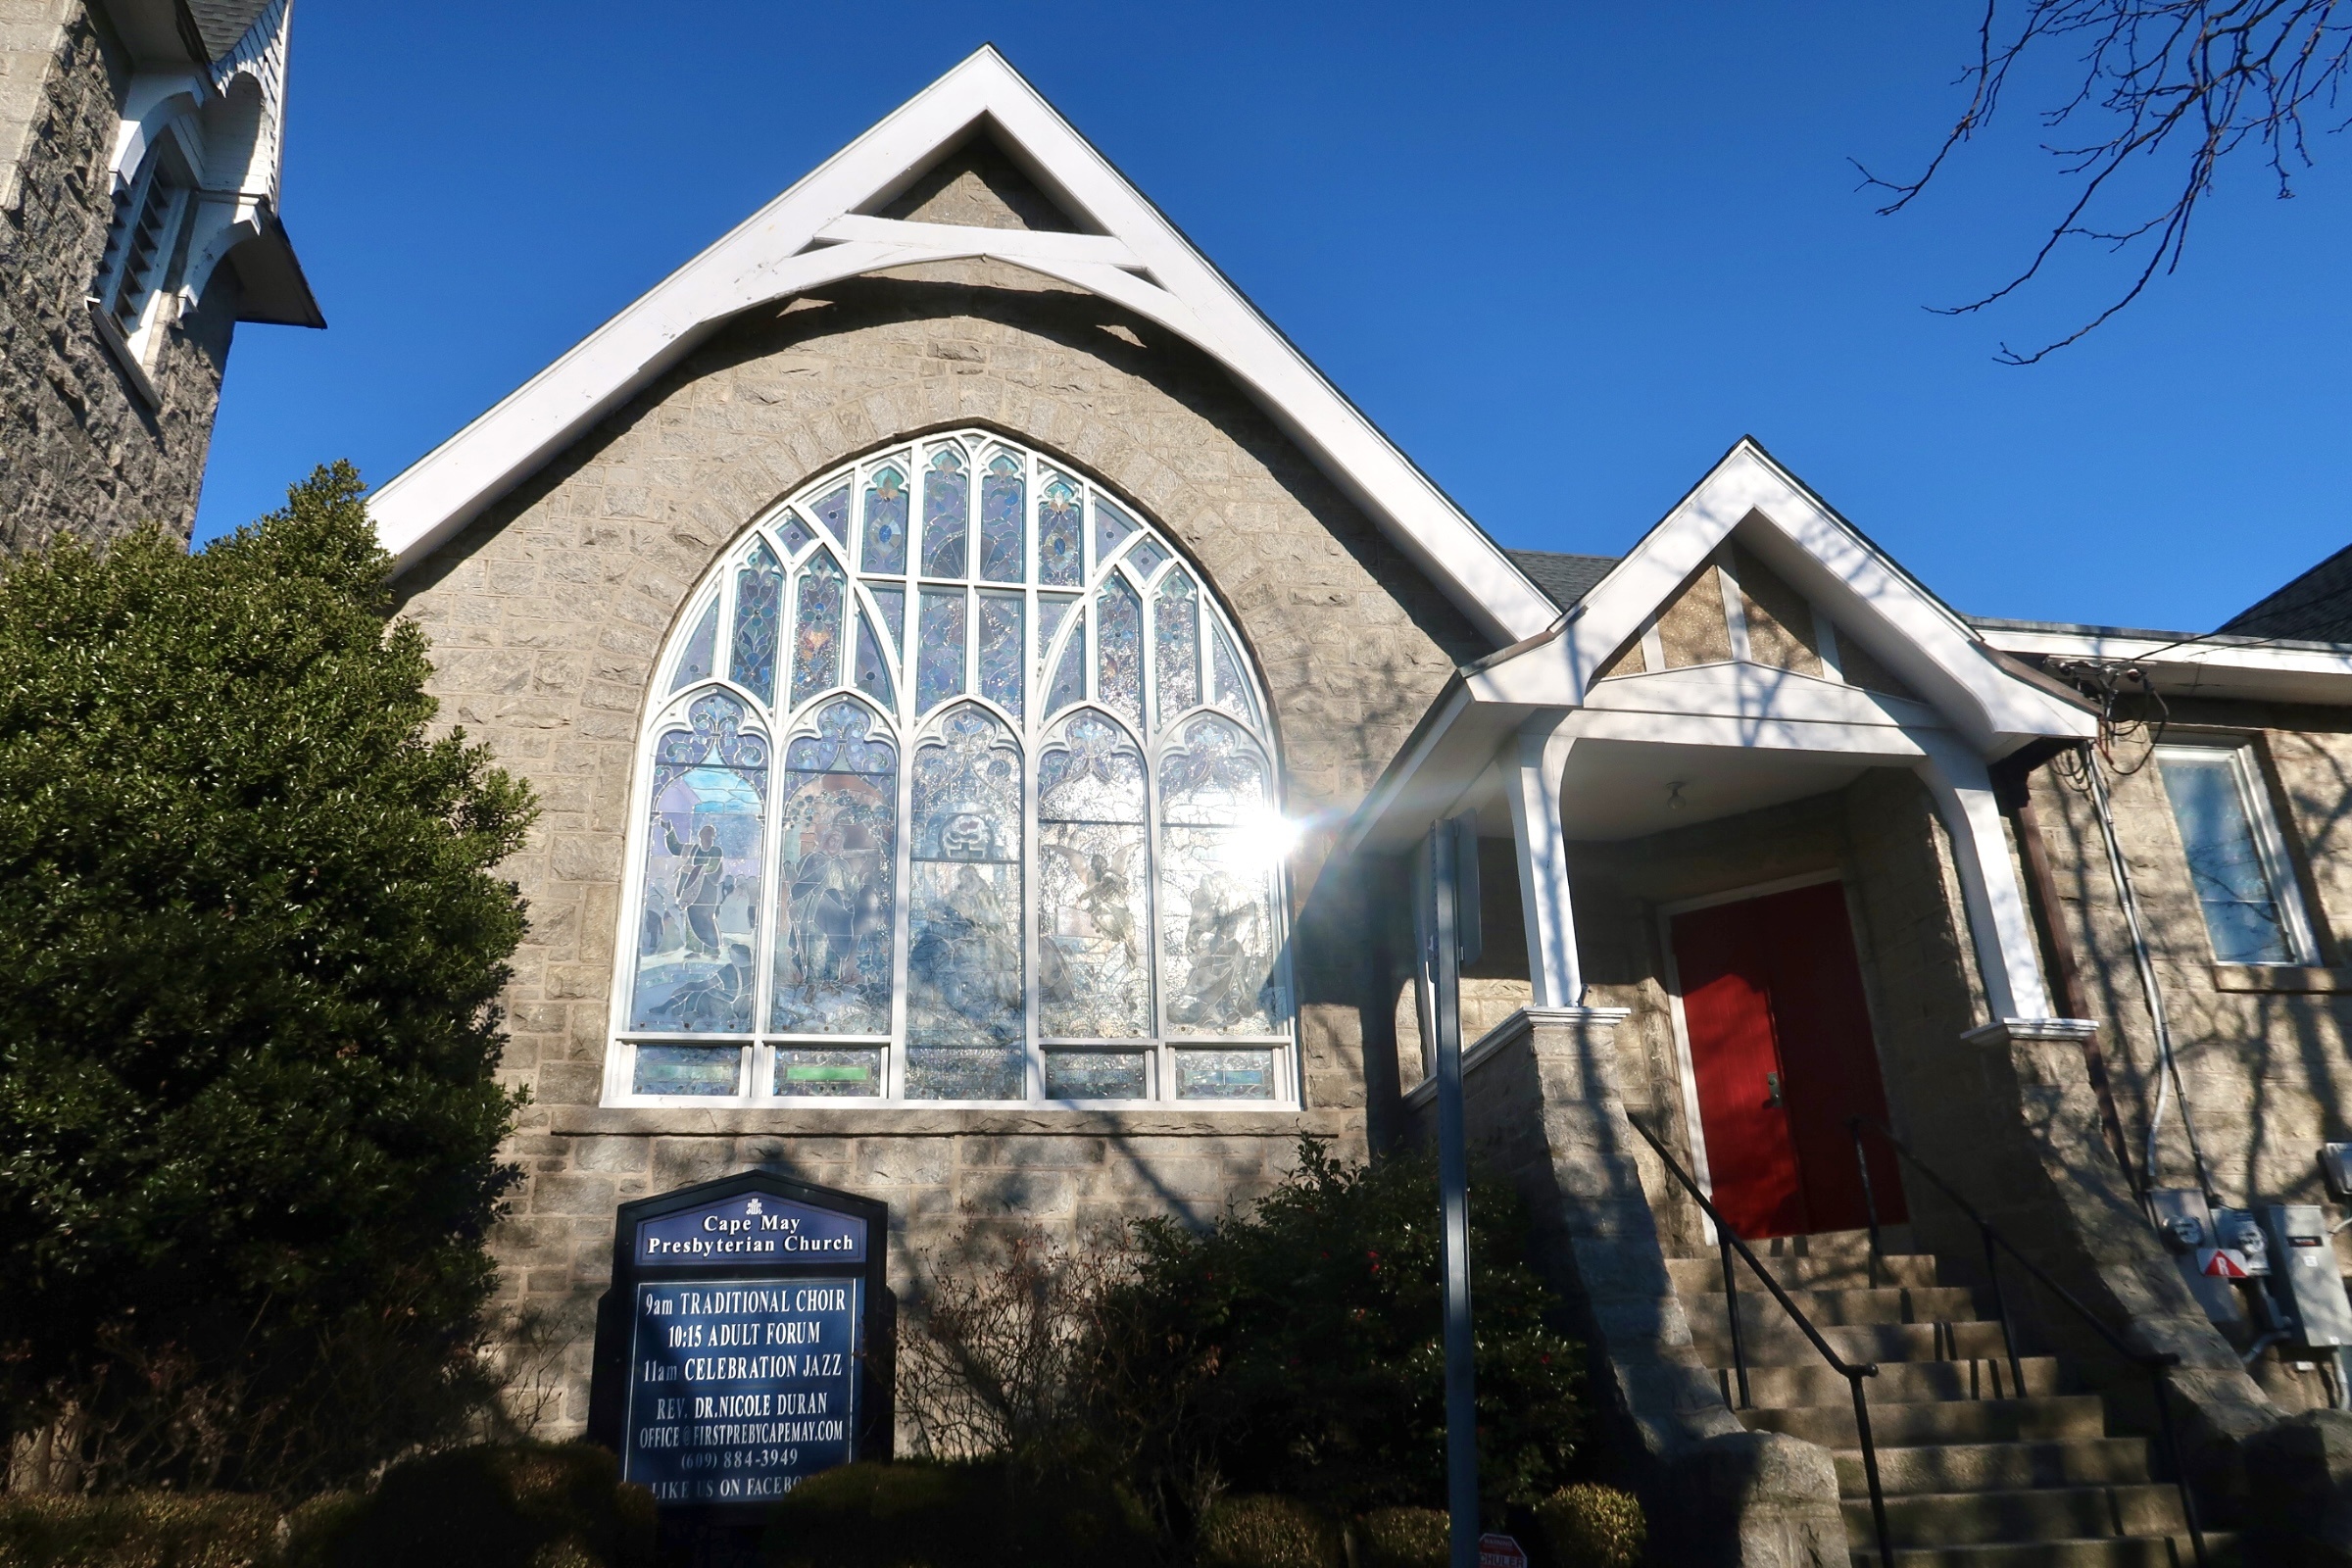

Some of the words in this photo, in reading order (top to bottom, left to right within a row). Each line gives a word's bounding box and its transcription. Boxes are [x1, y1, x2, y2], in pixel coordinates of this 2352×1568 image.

[704, 1215, 752, 1235] Cape
[760, 1214, 801, 1234] May
[648, 1236, 775, 1256] Presbyterian
[784, 1235, 854, 1251] Church
[2216, 1256, 2230, 1276] R
[646, 1294, 673, 1315] 9am
[680, 1290, 791, 1315] TRADITIONAL
[796, 1289, 846, 1312] CHOIR
[667, 1325, 703, 1348] 10:15
[708, 1323, 760, 1347] ADULT
[765, 1321, 821, 1346] FORUM
[643, 1359, 677, 1383] 11am
[684, 1355, 798, 1381] CELEBRATION
[803, 1353, 843, 1377] JAZZ
[657, 1397, 688, 1420] REV.
[694, 1395, 771, 1419] DR.NICOLE
[776, 1392, 828, 1416] DURAN
[681, 1451, 717, 1470] (609)
[723, 1447, 799, 1469] 884-3949
[652, 1481, 690, 1499] LIKE
[697, 1480, 713, 1498] US
[719, 1478, 740, 1496] ON
[746, 1475, 812, 1496] FACEBO
[1484, 1538, 1513, 1547] WARNING
[1479, 1553, 1524, 1568] CHULER
